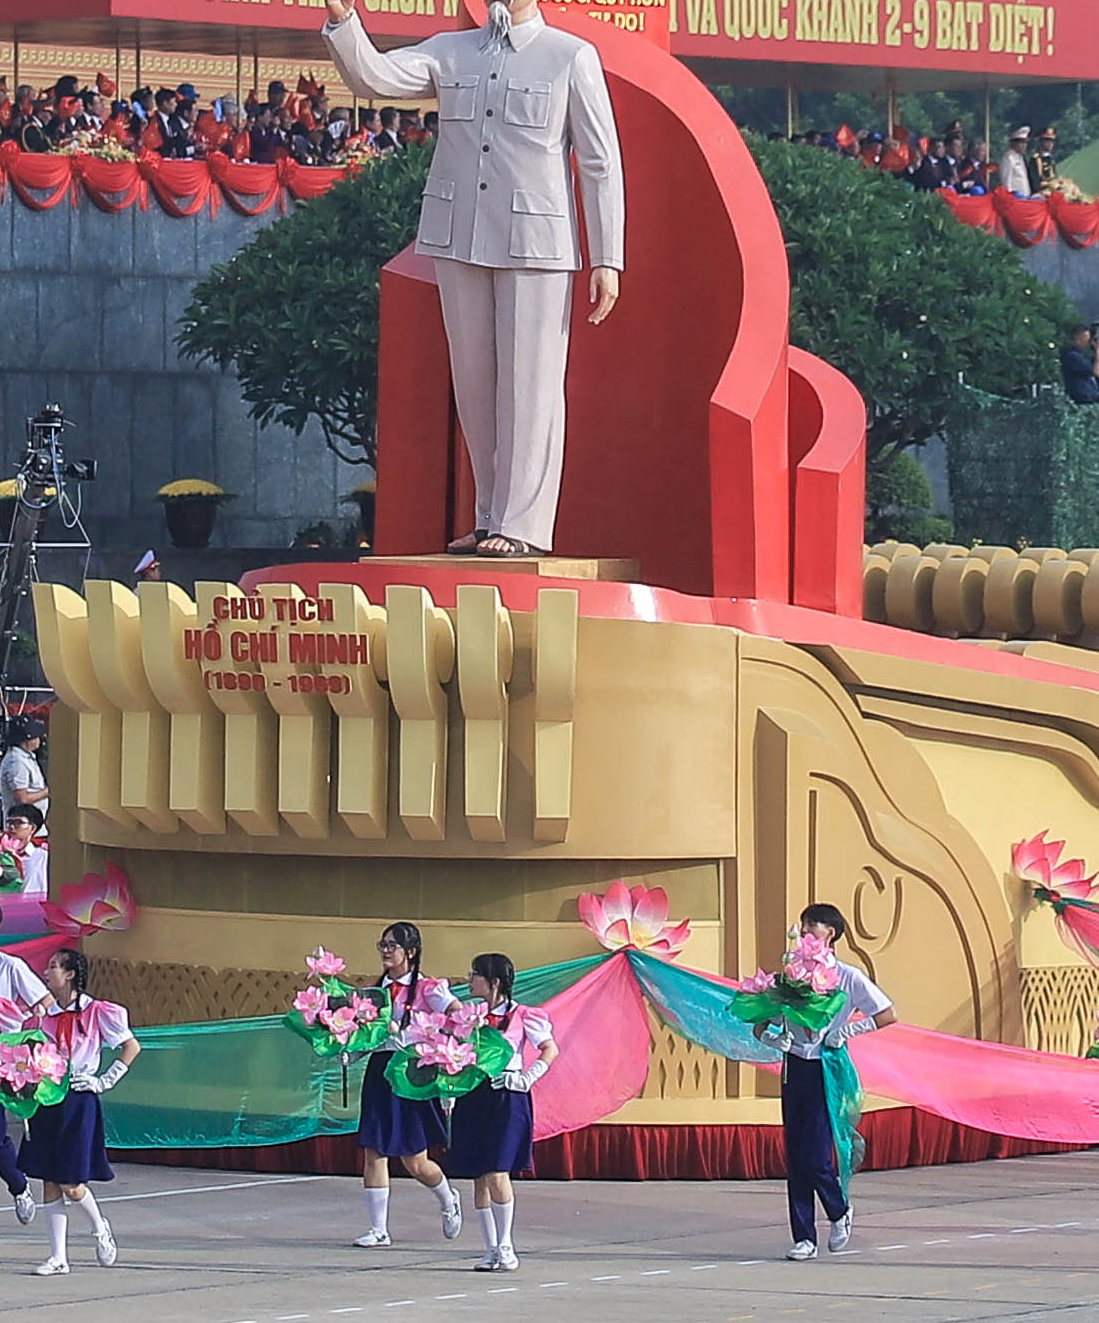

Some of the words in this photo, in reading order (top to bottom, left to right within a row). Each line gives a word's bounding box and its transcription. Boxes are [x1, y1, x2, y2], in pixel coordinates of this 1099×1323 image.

[213, 589, 265, 620] CHỦ
[272, 597, 334, 626] TỊCH
[184, 618, 222, 661] HỒ
[230, 625, 278, 662] CHÍ
[288, 633, 369, 665] MINH
